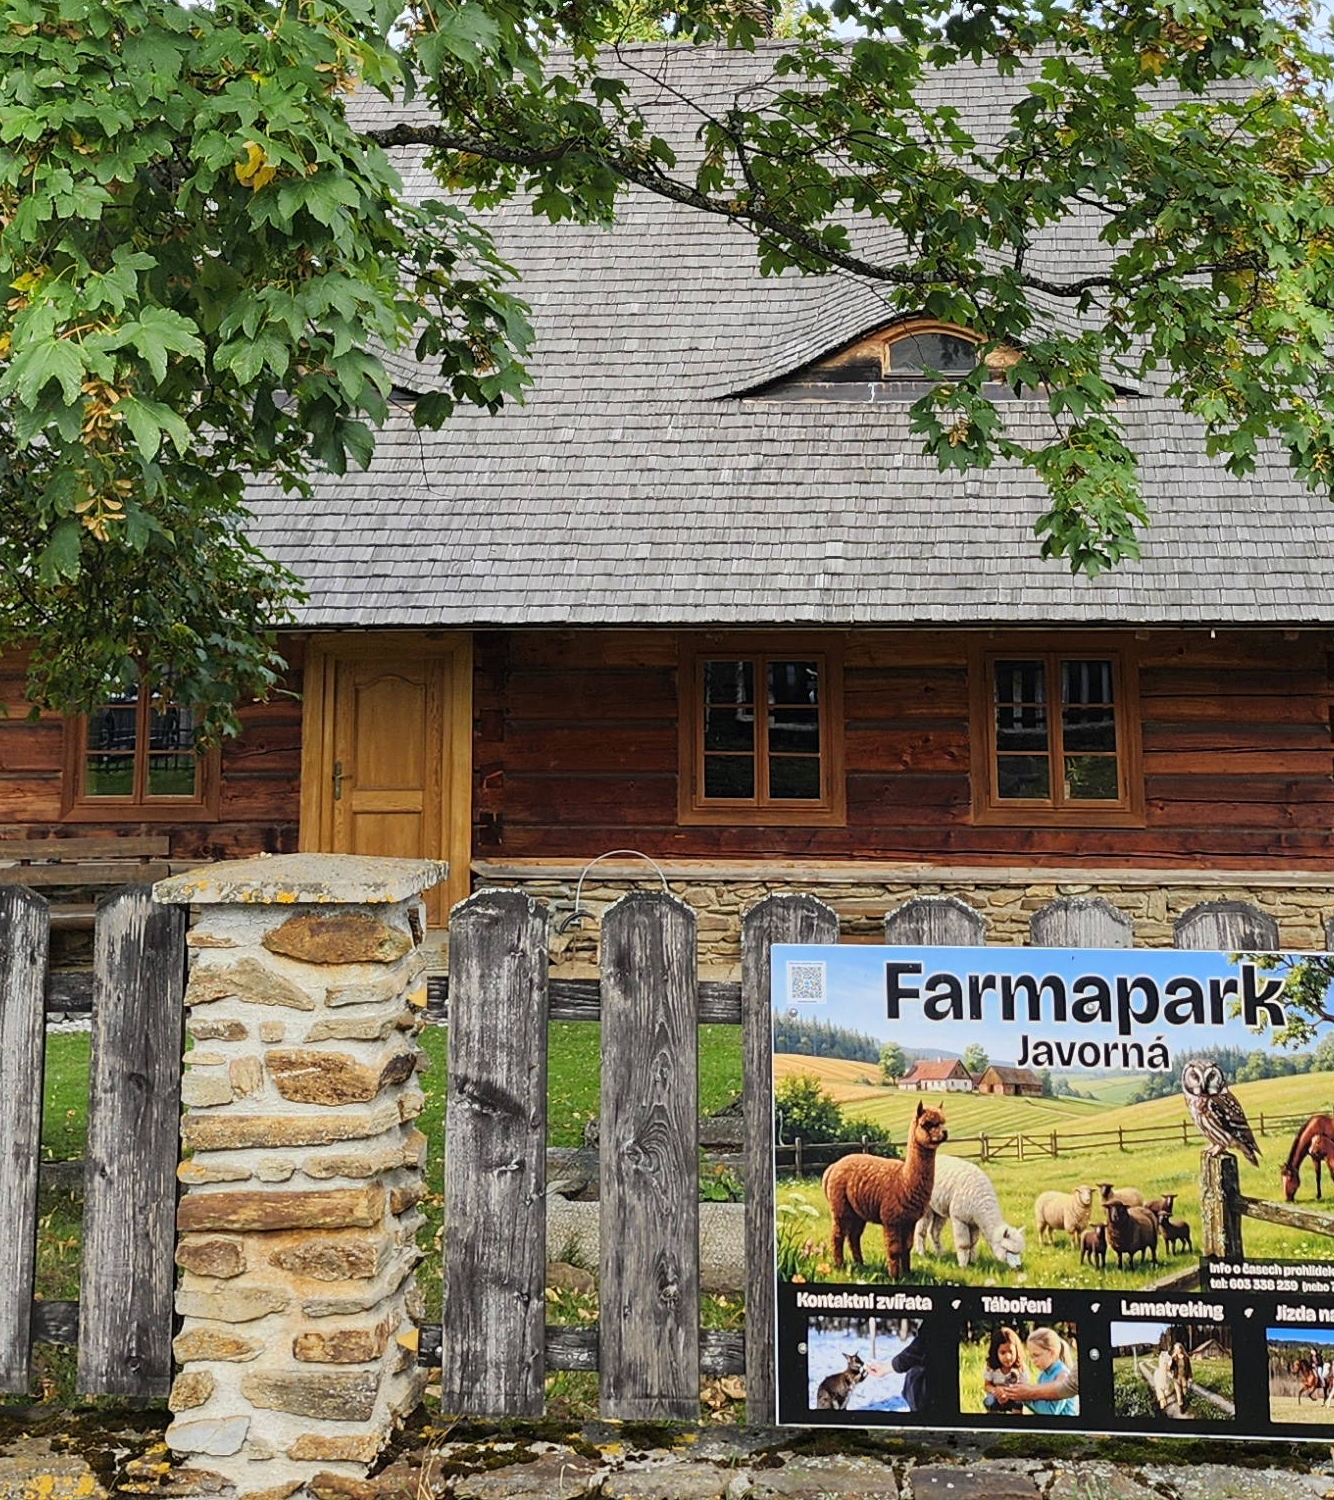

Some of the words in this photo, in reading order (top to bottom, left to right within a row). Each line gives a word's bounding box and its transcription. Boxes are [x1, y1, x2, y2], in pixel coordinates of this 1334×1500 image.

[884, 961, 1286, 1036] Farmapark
[1017, 1034, 1170, 1070] Javorná
[1209, 1261, 1232, 1274] Info
[1233, 1264, 1241, 1274] o
[1242, 1262, 1282, 1276] časech
[1210, 1277, 1229, 1289] tel:
[1229, 1278, 1252, 1290] 603
[1252, 1278, 1275, 1291] 338
[1276, 1279, 1299, 1292] 239
[1302, 1280, 1330, 1293] (nebo
[796, 1291, 874, 1311] Kontaktní
[876, 1293, 933, 1312] zvířata
[981, 1296, 1053, 1314] Táboření
[1120, 1299, 1224, 1322] Lamatreking
[1275, 1304, 1317, 1323] Jízda
